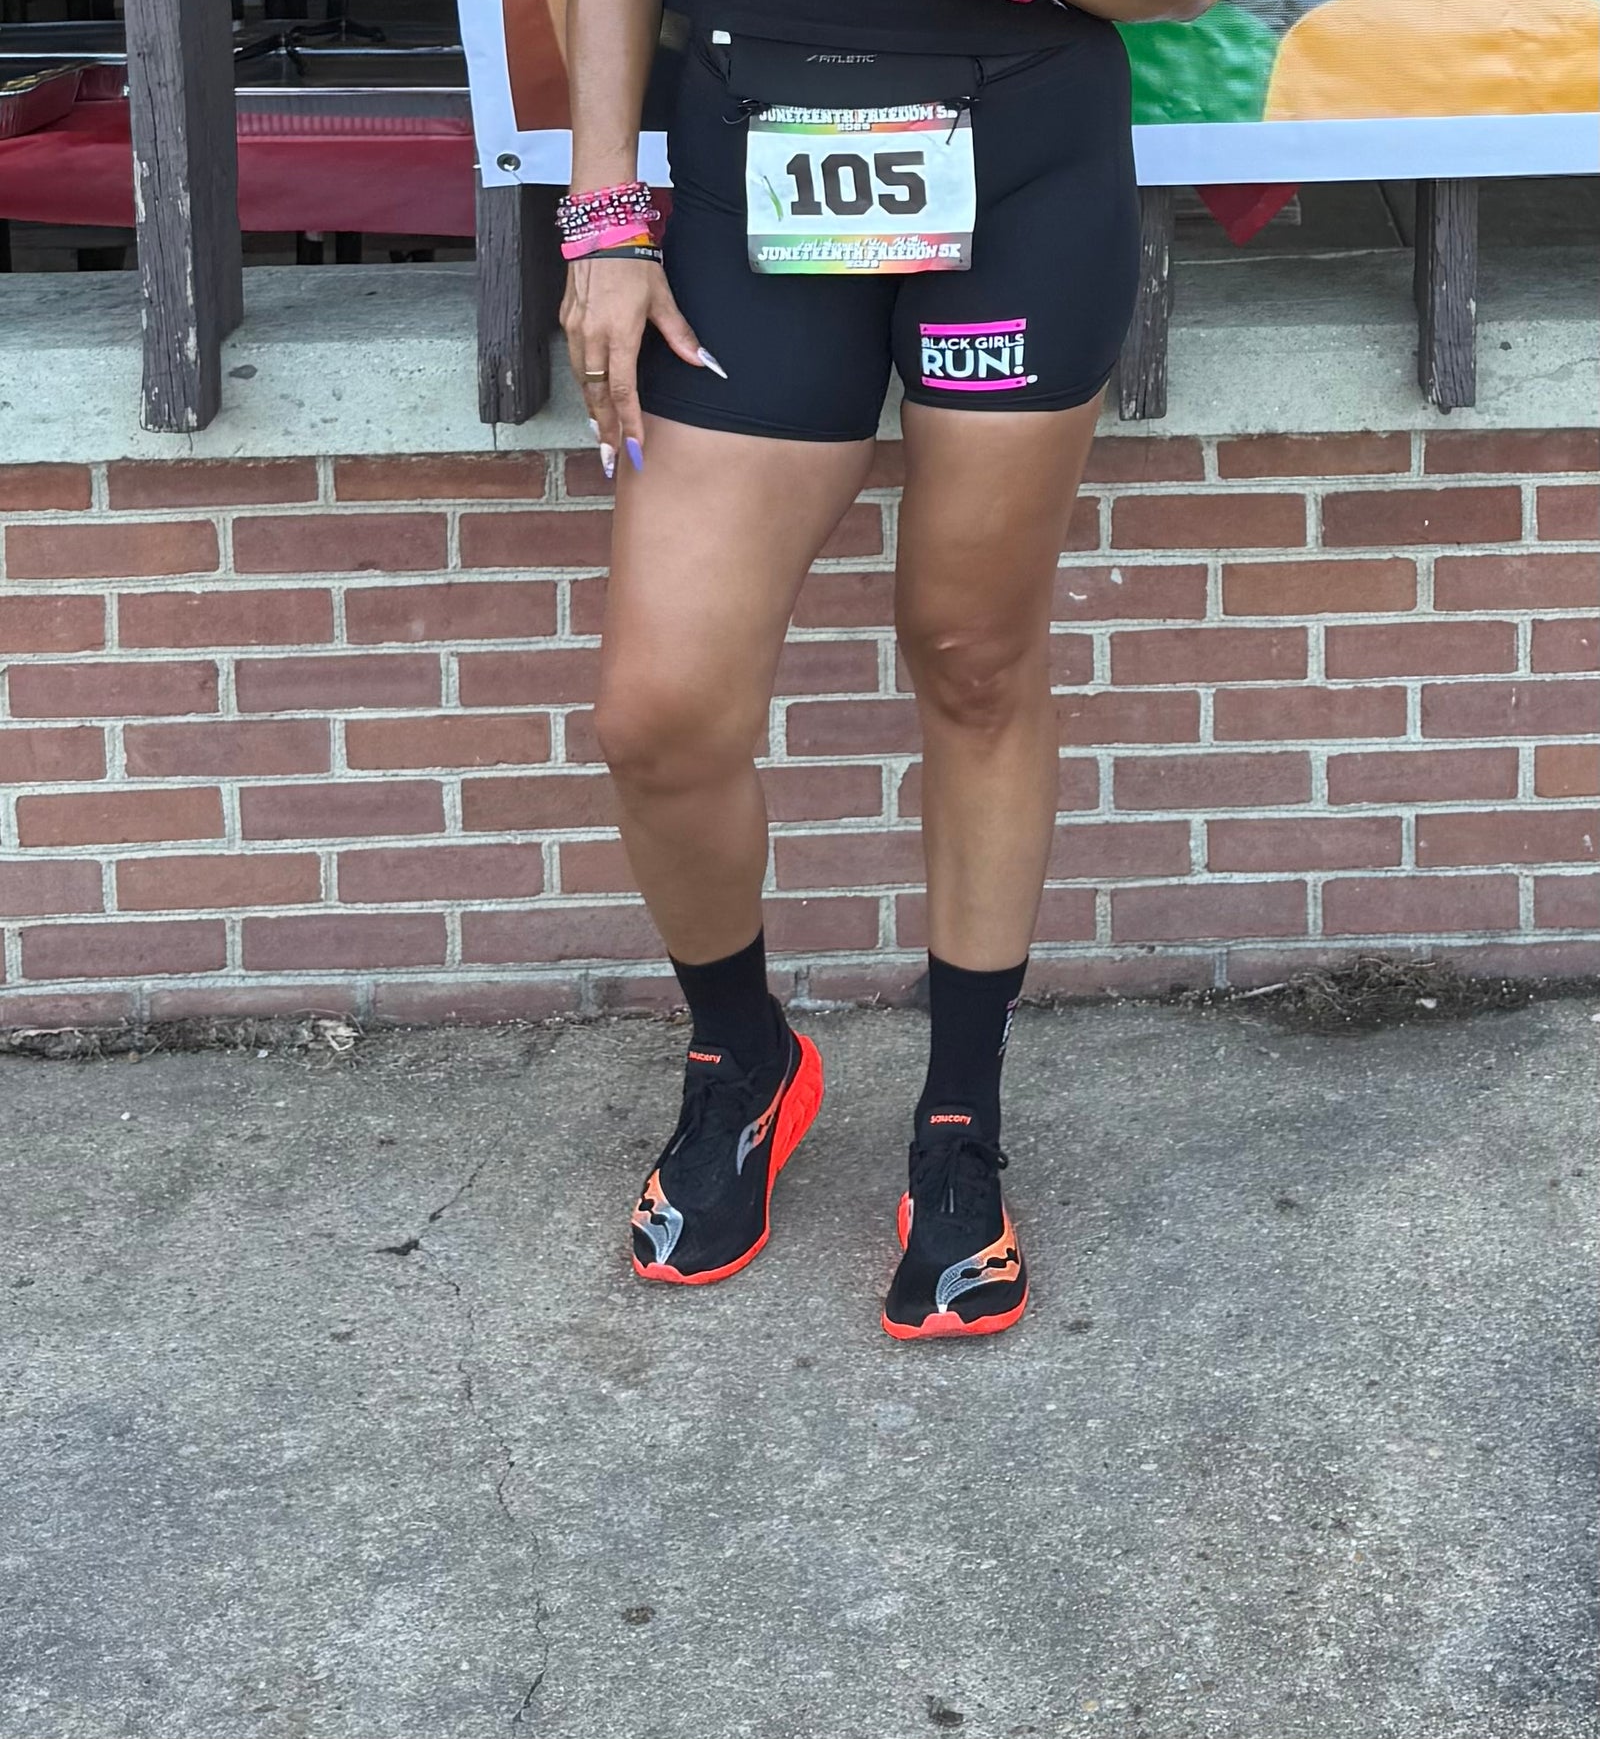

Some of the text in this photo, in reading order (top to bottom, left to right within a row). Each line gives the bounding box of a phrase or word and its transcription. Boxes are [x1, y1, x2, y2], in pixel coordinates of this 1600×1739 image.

[759, 106, 855, 123] JUNETEENTH
[857, 104, 934, 123] FREEDOM
[786, 151, 927, 215] 105
[757, 243, 961, 261] JUNETEENTH FREEDOM 5K
[921, 333, 1025, 350] BLACK GIRLS
[921, 345, 1025, 378] RUN!
[930, 1114, 972, 1126] saucony
